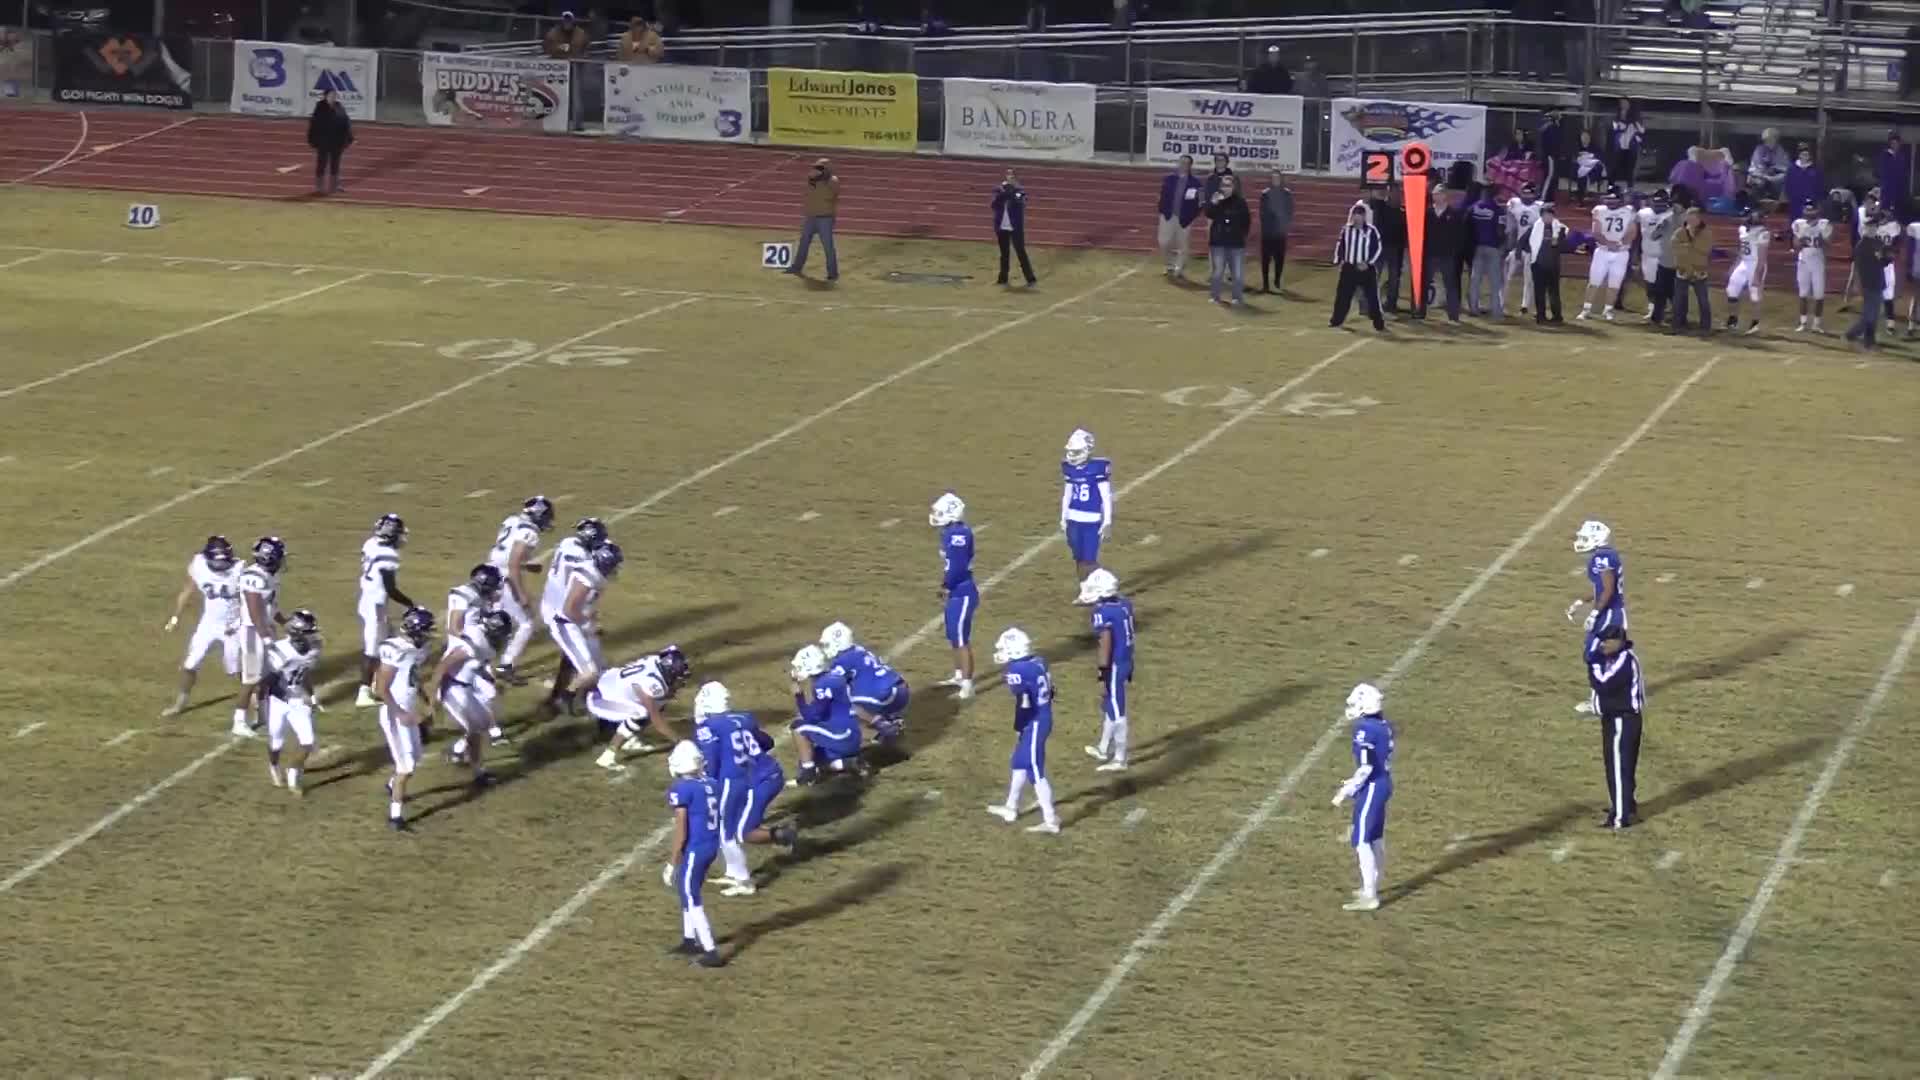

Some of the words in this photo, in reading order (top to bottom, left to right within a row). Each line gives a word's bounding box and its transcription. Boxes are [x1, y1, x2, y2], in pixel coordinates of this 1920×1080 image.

[436, 69, 520, 97] BUDDY'S
[789, 78, 846, 93] Edward
[848, 80, 896, 96] Jones
[799, 103, 888, 119] INVESTMENTS
[1201, 99, 1254, 117] HNB
[962, 106, 1076, 131] BANDERA
[1153, 119, 1201, 131] BANDERA
[1203, 121, 1251, 135] BANKING
[1253, 126, 1294, 137] CENTER
[1162, 141, 1184, 154] GO
[1365, 155, 1390, 183] 2
[130, 207, 154, 225] 10
[1520, 215, 1529, 226] 6
[1605, 217, 1624, 232] 73
[765, 245, 790, 265] 20
[951, 535, 967, 546] 25
[1093, 613, 1103, 627] 11
[1006, 673, 1022, 685] 20
[816, 687, 833, 700] 54
[669, 792, 679, 806] 5
[706, 796, 719, 831] 5
